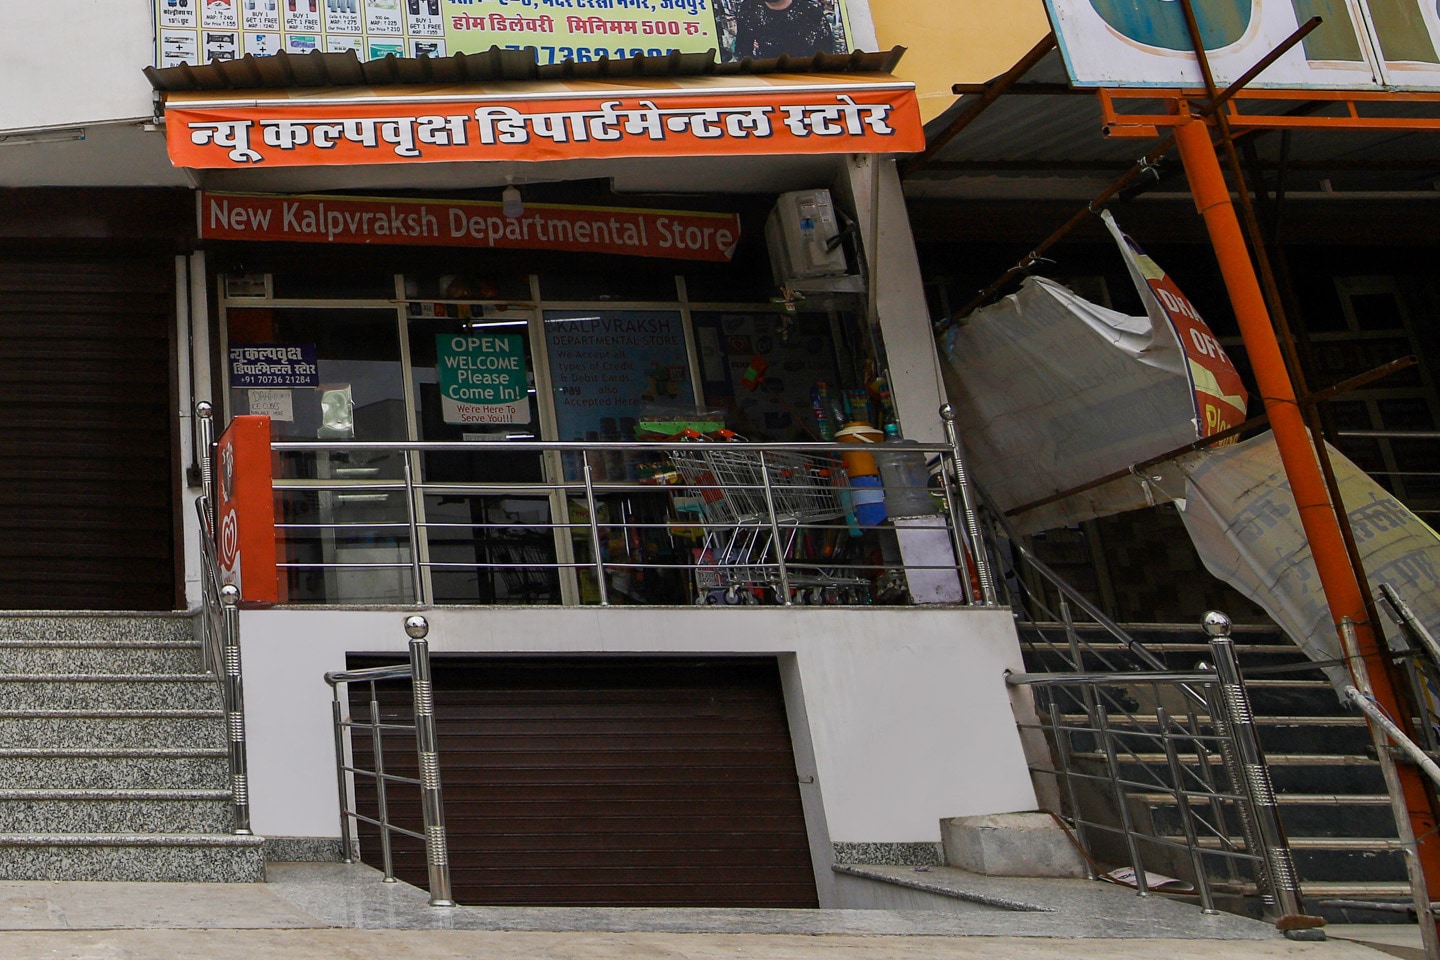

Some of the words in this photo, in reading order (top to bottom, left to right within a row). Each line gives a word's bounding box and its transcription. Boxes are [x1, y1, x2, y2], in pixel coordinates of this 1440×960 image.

[451, 12, 486, 32] होम
[488, 13, 555, 34] डिलेवरी
[566, 15, 638, 36] मिनिमम
[642, 21, 680, 36] 500
[188, 119, 264, 163] न्यू
[259, 114, 470, 158] कल्पवृक्ष
[474, 100, 773, 145] डिपार्टमेन्टल
[779, 95, 895, 138] स्टोर
[210, 199, 273, 232] New
[283, 202, 439, 242] Kalpvraksh
[450, 207, 649, 248] Departmental
[657, 217, 733, 253] Store
[557, 319, 671, 334] KALPVRAKSH
[450, 337, 510, 353] OPEN
[553, 335, 641, 346] DEPARTMENTAL
[643, 335, 679, 346] STORE
[229, 348, 248, 363] न्यू
[244, 347, 303, 365] कल्पवृक्ष
[575, 351, 611, 361] Accept
[294, 363, 317, 375] स्टोर
[444, 356, 520, 370] WELCOME
[558, 362, 585, 372] types
[602, 362, 634, 371] Credit
[257, 376, 283, 384] 70736
[285, 376, 311, 384] 21284
[458, 370, 510, 385] Please
[571, 374, 598, 382] Debit
[449, 385, 495, 400] Come
[500, 385, 521, 400] In!
[598, 386, 618, 394] also
[564, 397, 612, 408] Accepted
[456, 405, 481, 414] We're
[483, 405, 504, 414] Here
[505, 405, 516, 414] To
[461, 413, 486, 423] Serve
[487, 414, 513, 423] You!!!
